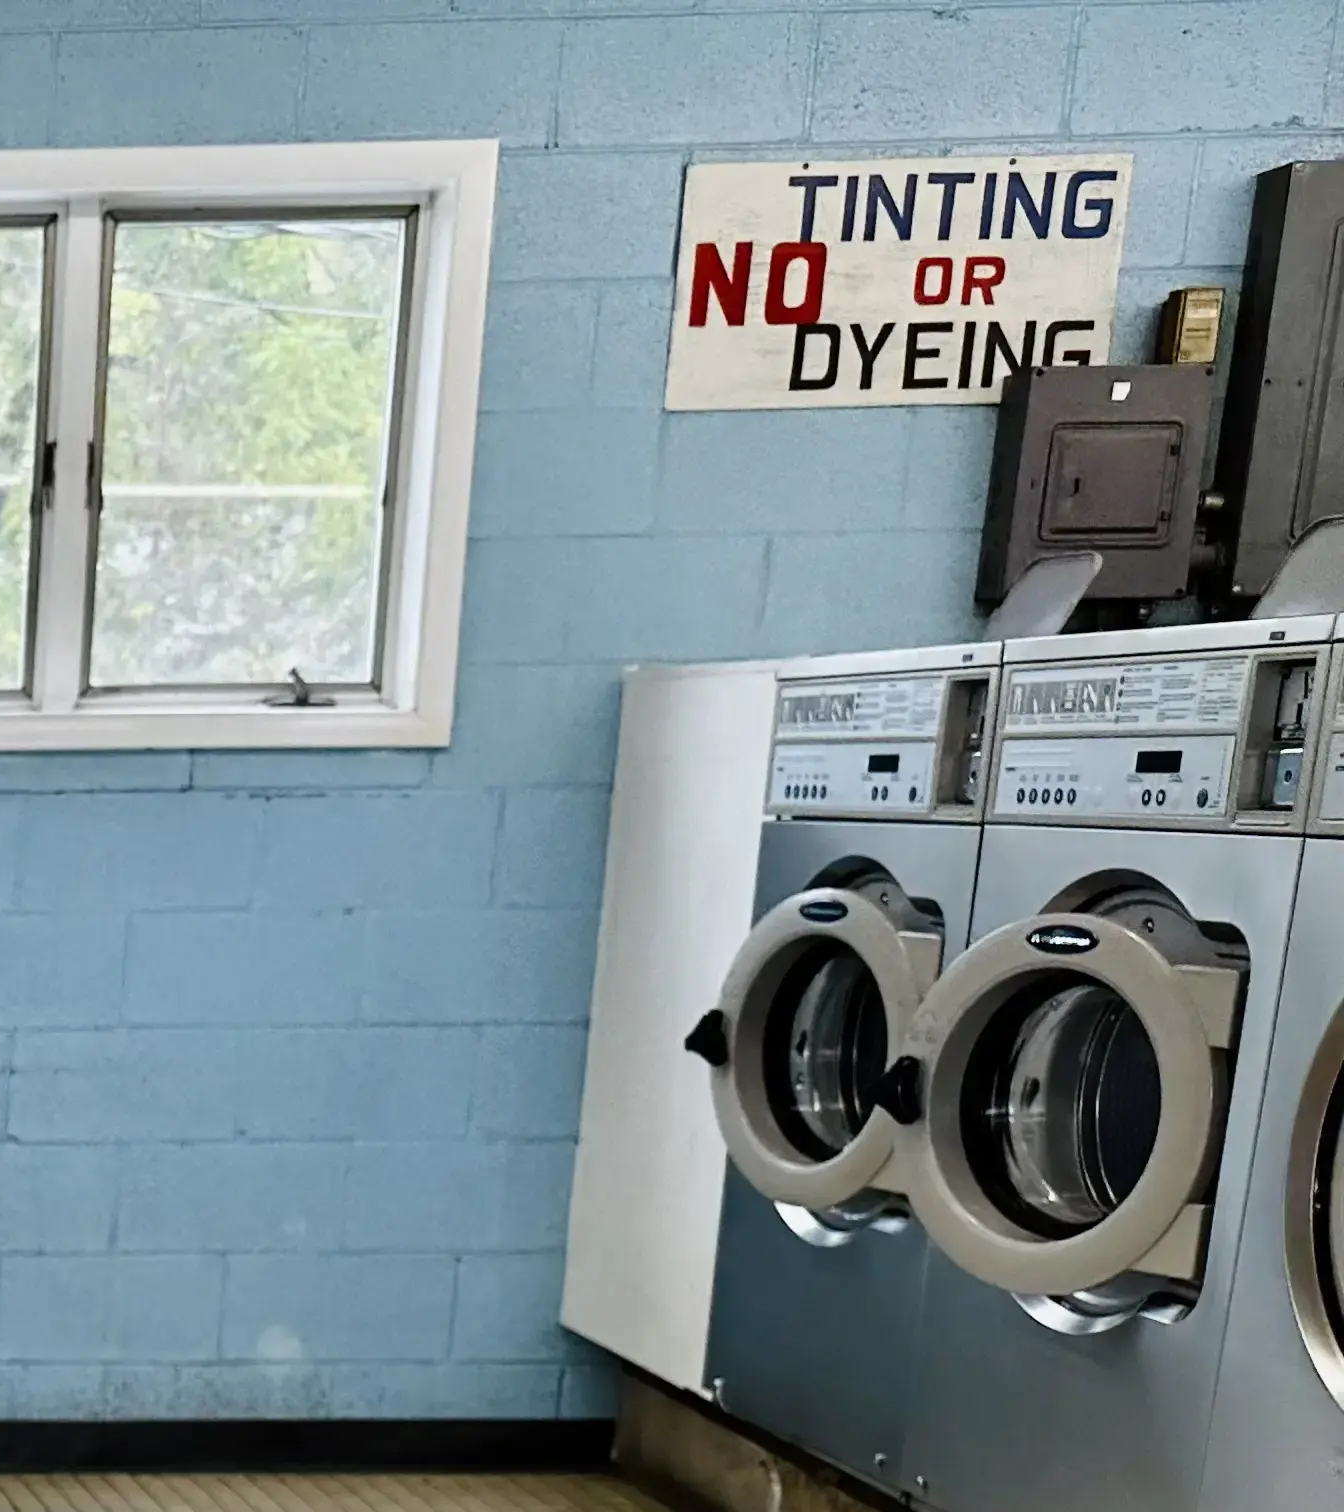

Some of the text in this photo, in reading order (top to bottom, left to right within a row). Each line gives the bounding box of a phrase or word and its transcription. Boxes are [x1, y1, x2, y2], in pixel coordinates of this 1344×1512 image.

[788, 170, 1118, 243] TINTING
[688, 241, 828, 328] NO
[913, 256, 1006, 307] OR
[788, 320, 1096, 391] DYEING
